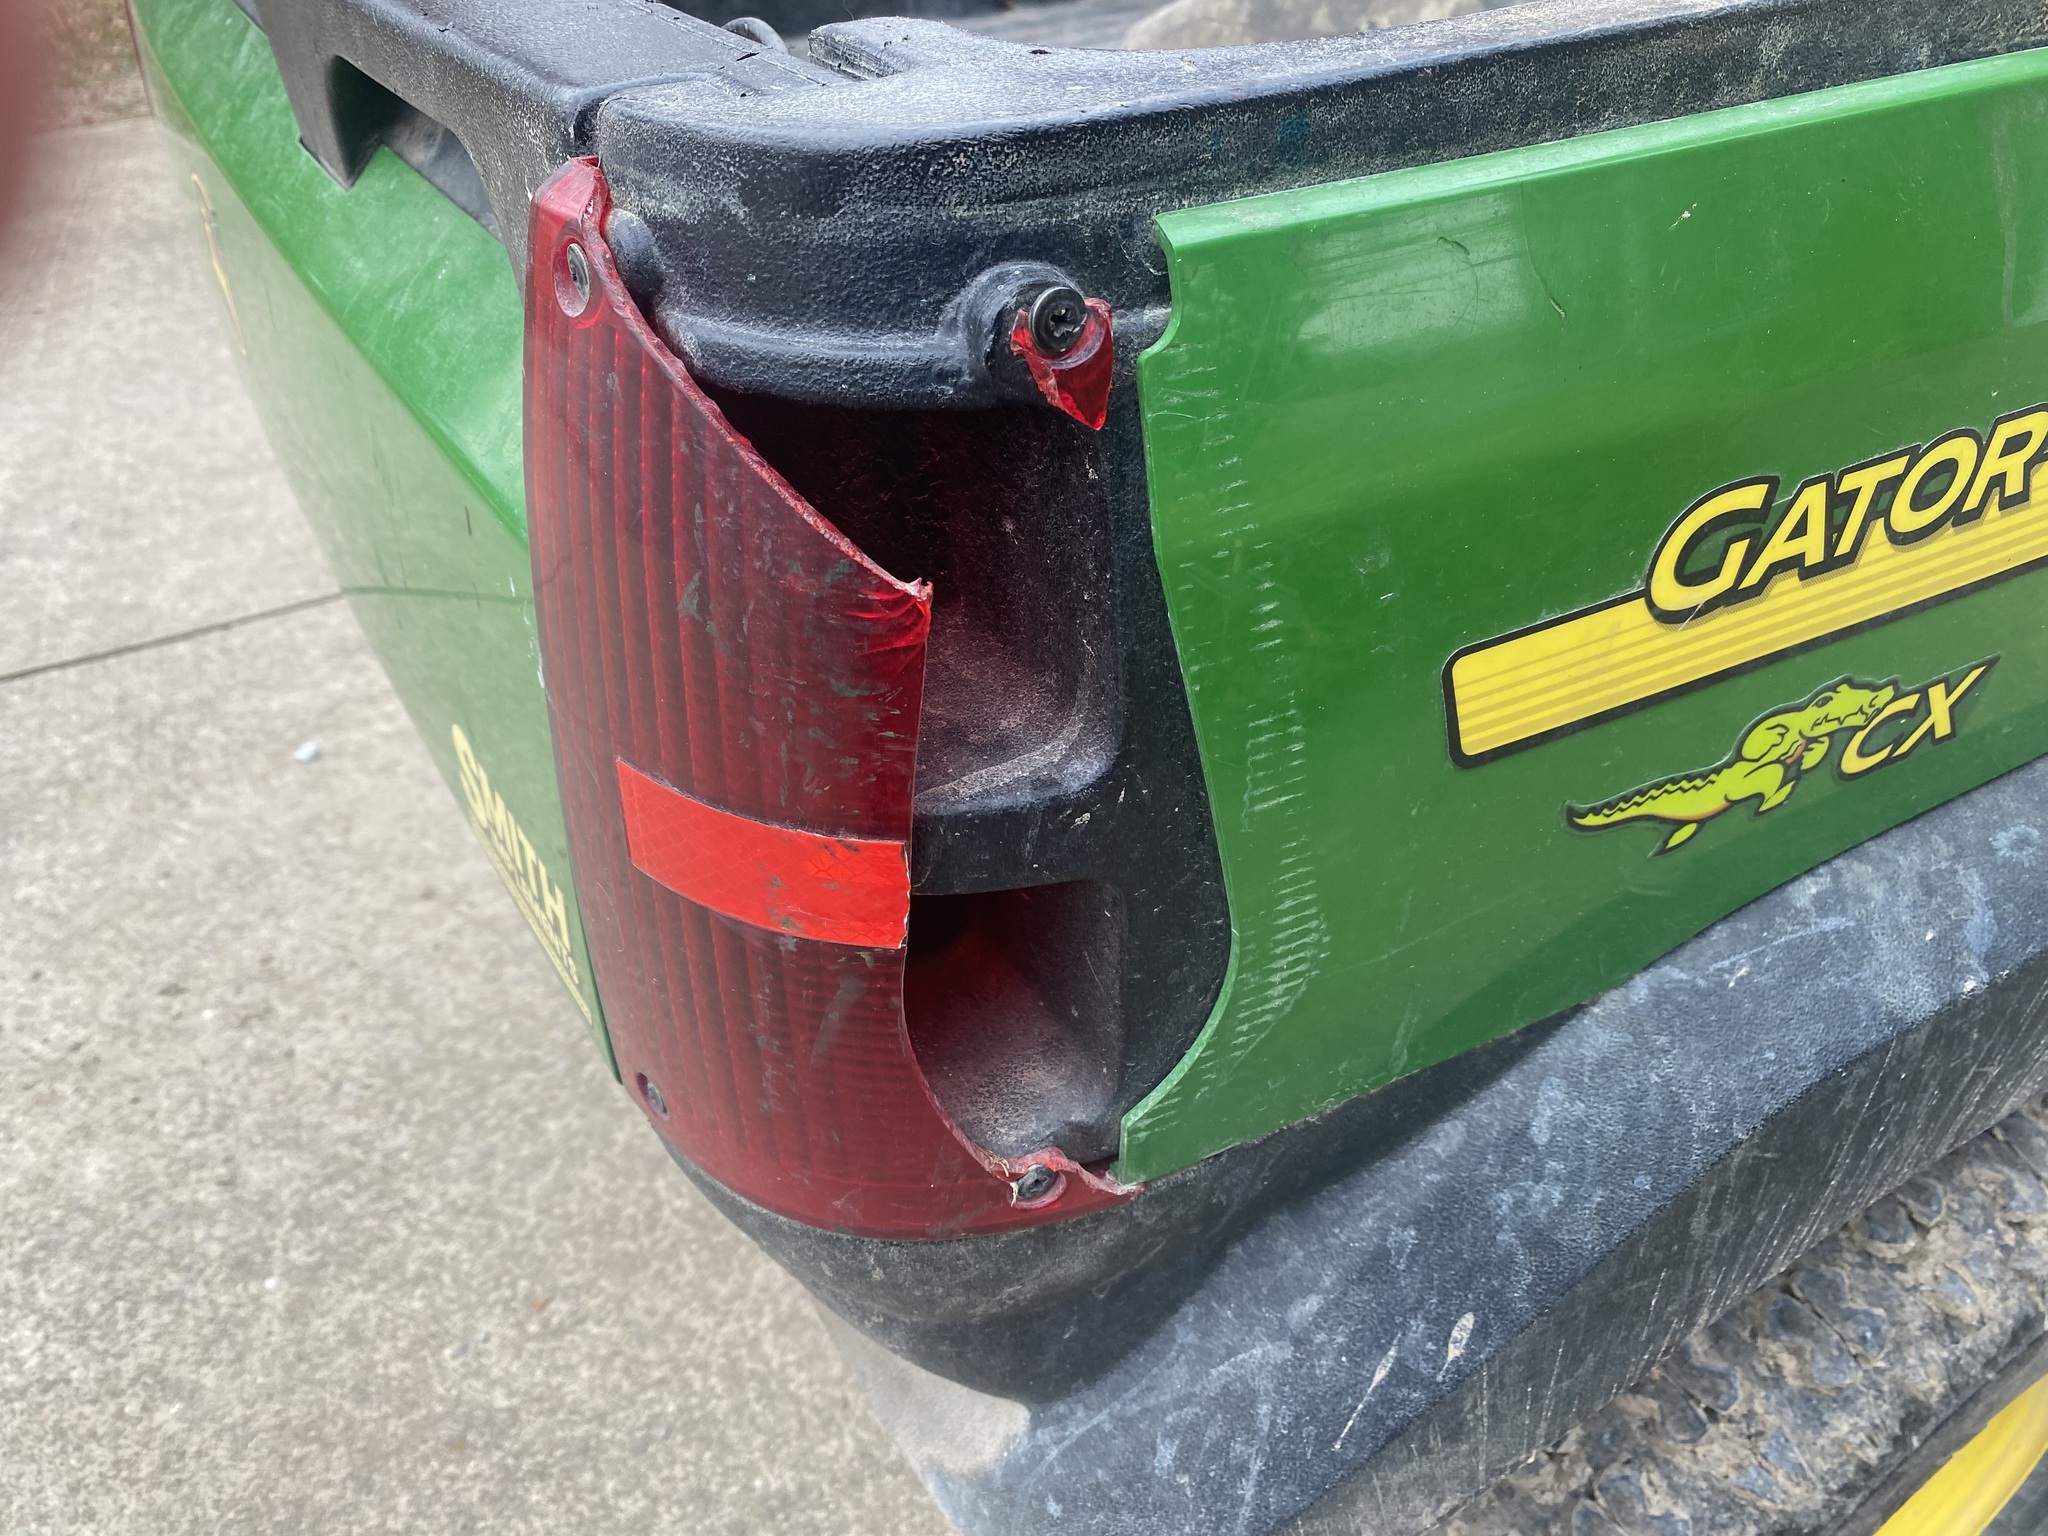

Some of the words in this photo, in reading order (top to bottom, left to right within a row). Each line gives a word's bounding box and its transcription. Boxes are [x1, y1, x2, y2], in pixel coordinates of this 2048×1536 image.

[1647, 408, 2048, 614] GATOR
[1838, 665, 1989, 775] CX
[452, 724, 571, 954] SMITH
